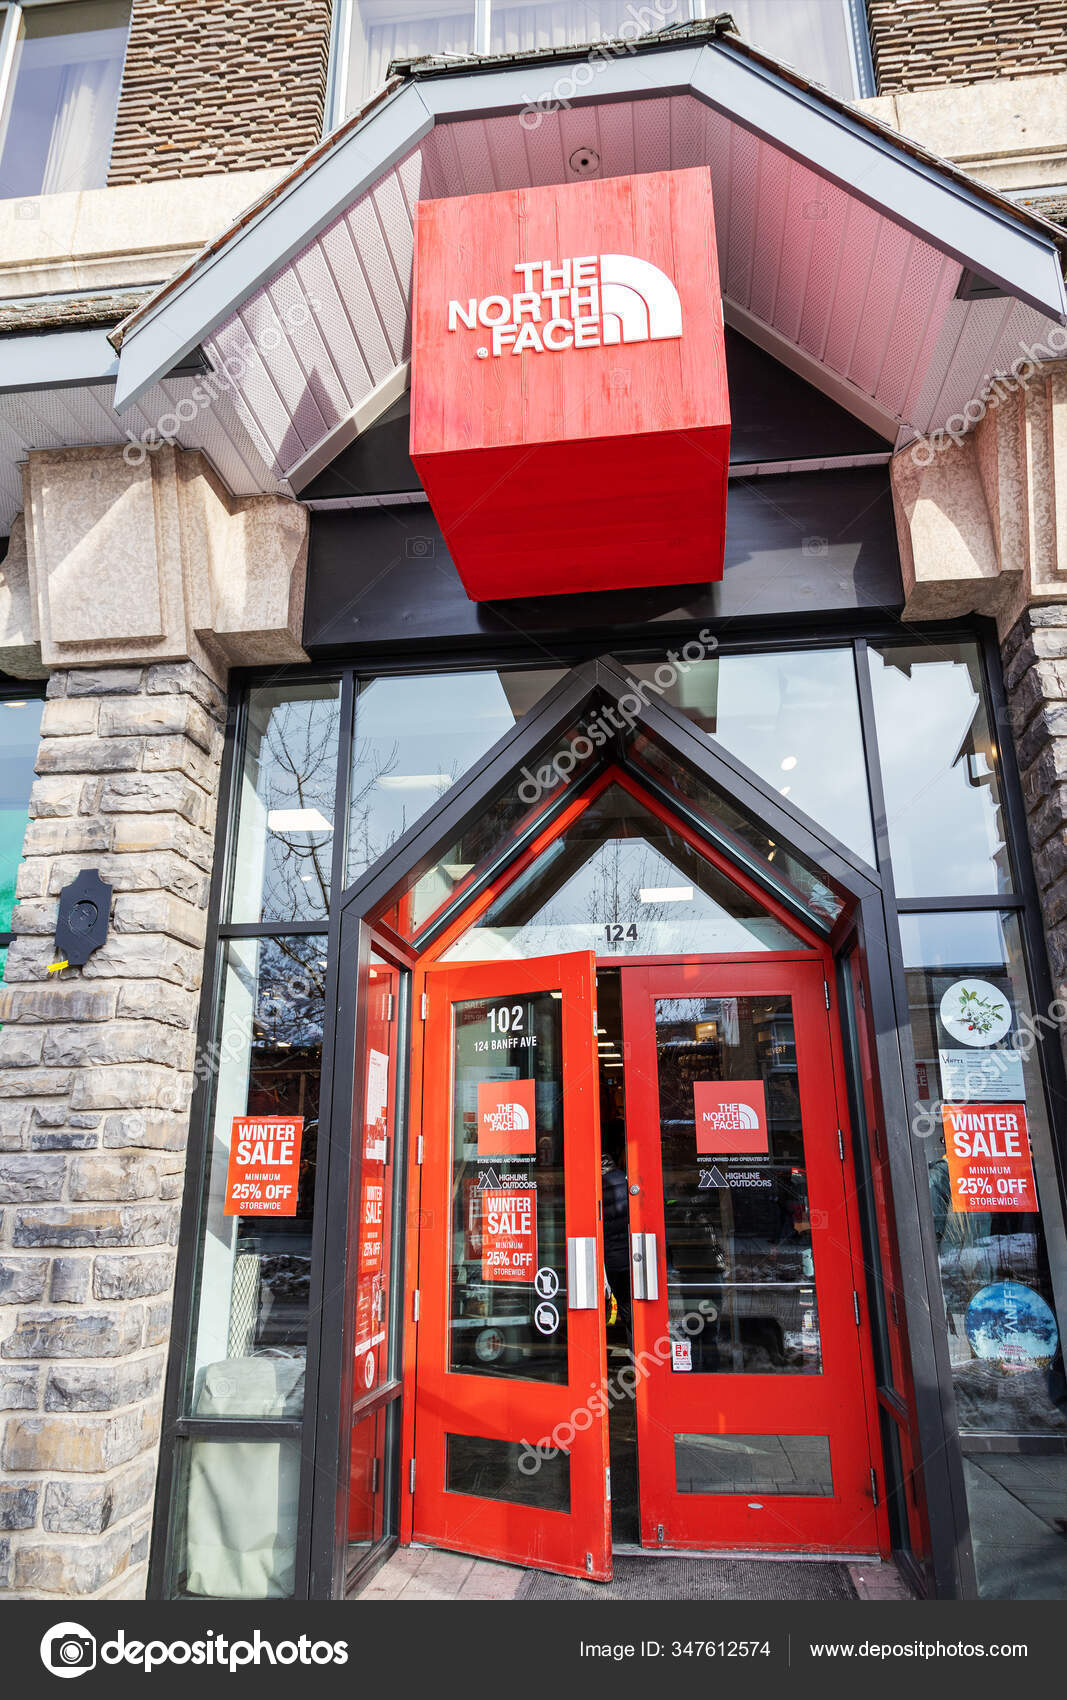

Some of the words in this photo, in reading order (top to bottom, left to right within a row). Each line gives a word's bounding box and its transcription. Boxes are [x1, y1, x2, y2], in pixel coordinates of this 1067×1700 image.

[514, 255, 599, 293] THE
[448, 285, 600, 332] NORTH
[491, 314, 601, 358] FACE
[604, 923, 638, 942] 124
[486, 1005, 524, 1033] 102
[474, 1040, 489, 1052] 124
[491, 1037, 519, 1051] BANFF
[520, 1035, 537, 1048] AVE
[496, 1103, 514, 1113] THE
[717, 1103, 739, 1112] THE
[483, 1112, 514, 1123] NORTH
[702, 1112, 739, 1122] NORTH
[950, 1113, 1019, 1132] WINTER
[238, 1124, 296, 1141] WINTER
[953, 1132, 1022, 1158] SALE
[235, 1141, 294, 1165] SALE
[244, 1173, 281, 1181] MINIMUM
[498, 1173, 528, 1181] HIGHLINE
[725, 1172, 760, 1180] HIGHLINE
[969, 1166, 1011, 1175] MINIMUM
[231, 1183, 262, 1199] 25%
[265, 1184, 293, 1199] OFF
[502, 1181, 538, 1189] OUTDOORS
[957, 1177, 993, 1194] 25%
[997, 1178, 1027, 1194] OFF
[239, 1201, 281, 1210] STOREWIDE
[487, 1197, 532, 1212] WINTER
[970, 1197, 1019, 1206] STOREWIDE
[365, 1201, 382, 1224] SALE
[486, 1212, 532, 1235] SALE
[495, 1241, 523, 1249] MINIMUM
[486, 1251, 510, 1266] 25%
[512, 1252, 533, 1266] OFF
[493, 1268, 526, 1276] STOREWIDE
